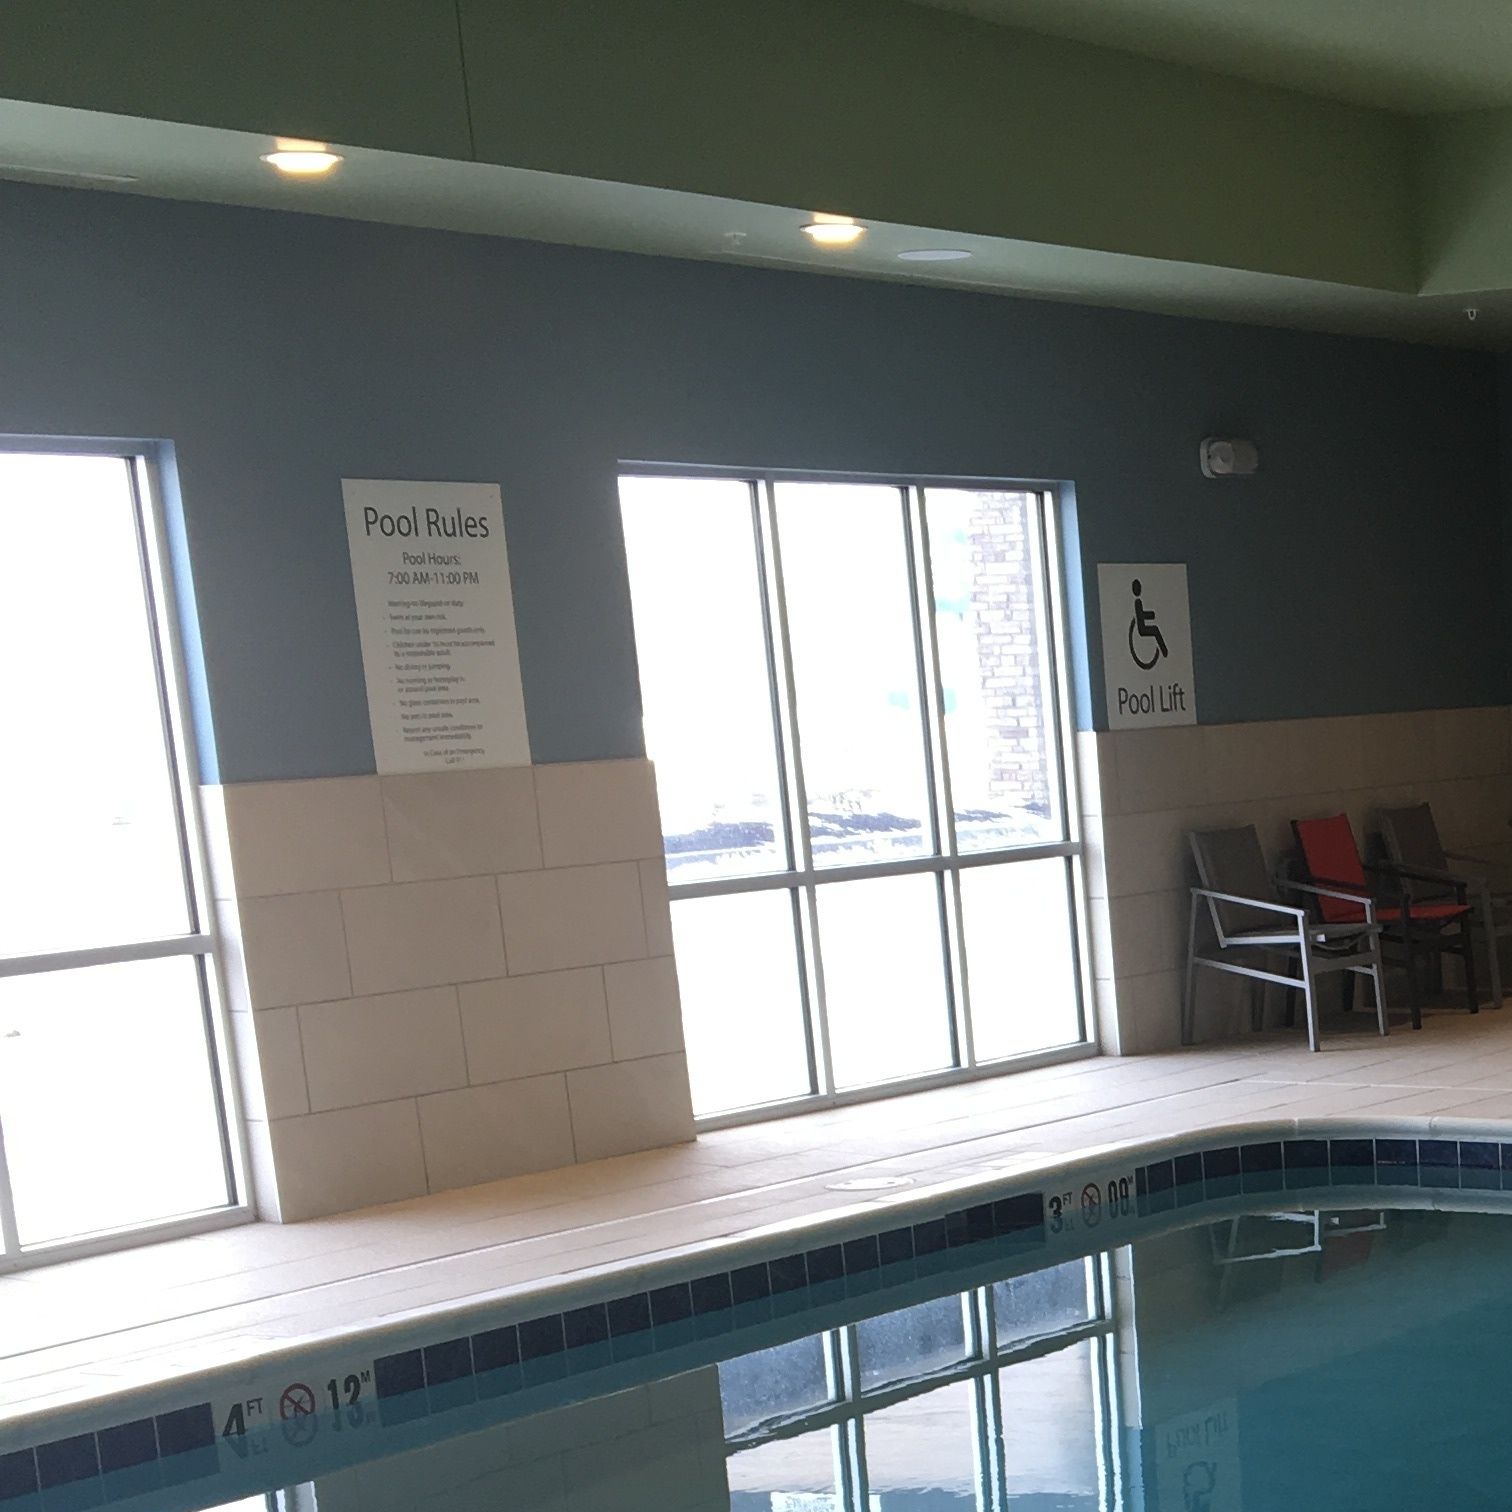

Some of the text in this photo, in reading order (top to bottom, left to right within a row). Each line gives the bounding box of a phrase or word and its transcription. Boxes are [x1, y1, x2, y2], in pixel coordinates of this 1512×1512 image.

[364, 506, 489, 538] Pool Rules
[402, 551, 425, 565] Pool
[387, 571, 410, 584] 7:00
[463, 572, 480, 584] PM
[1118, 683, 1186, 715] Pool Lift
